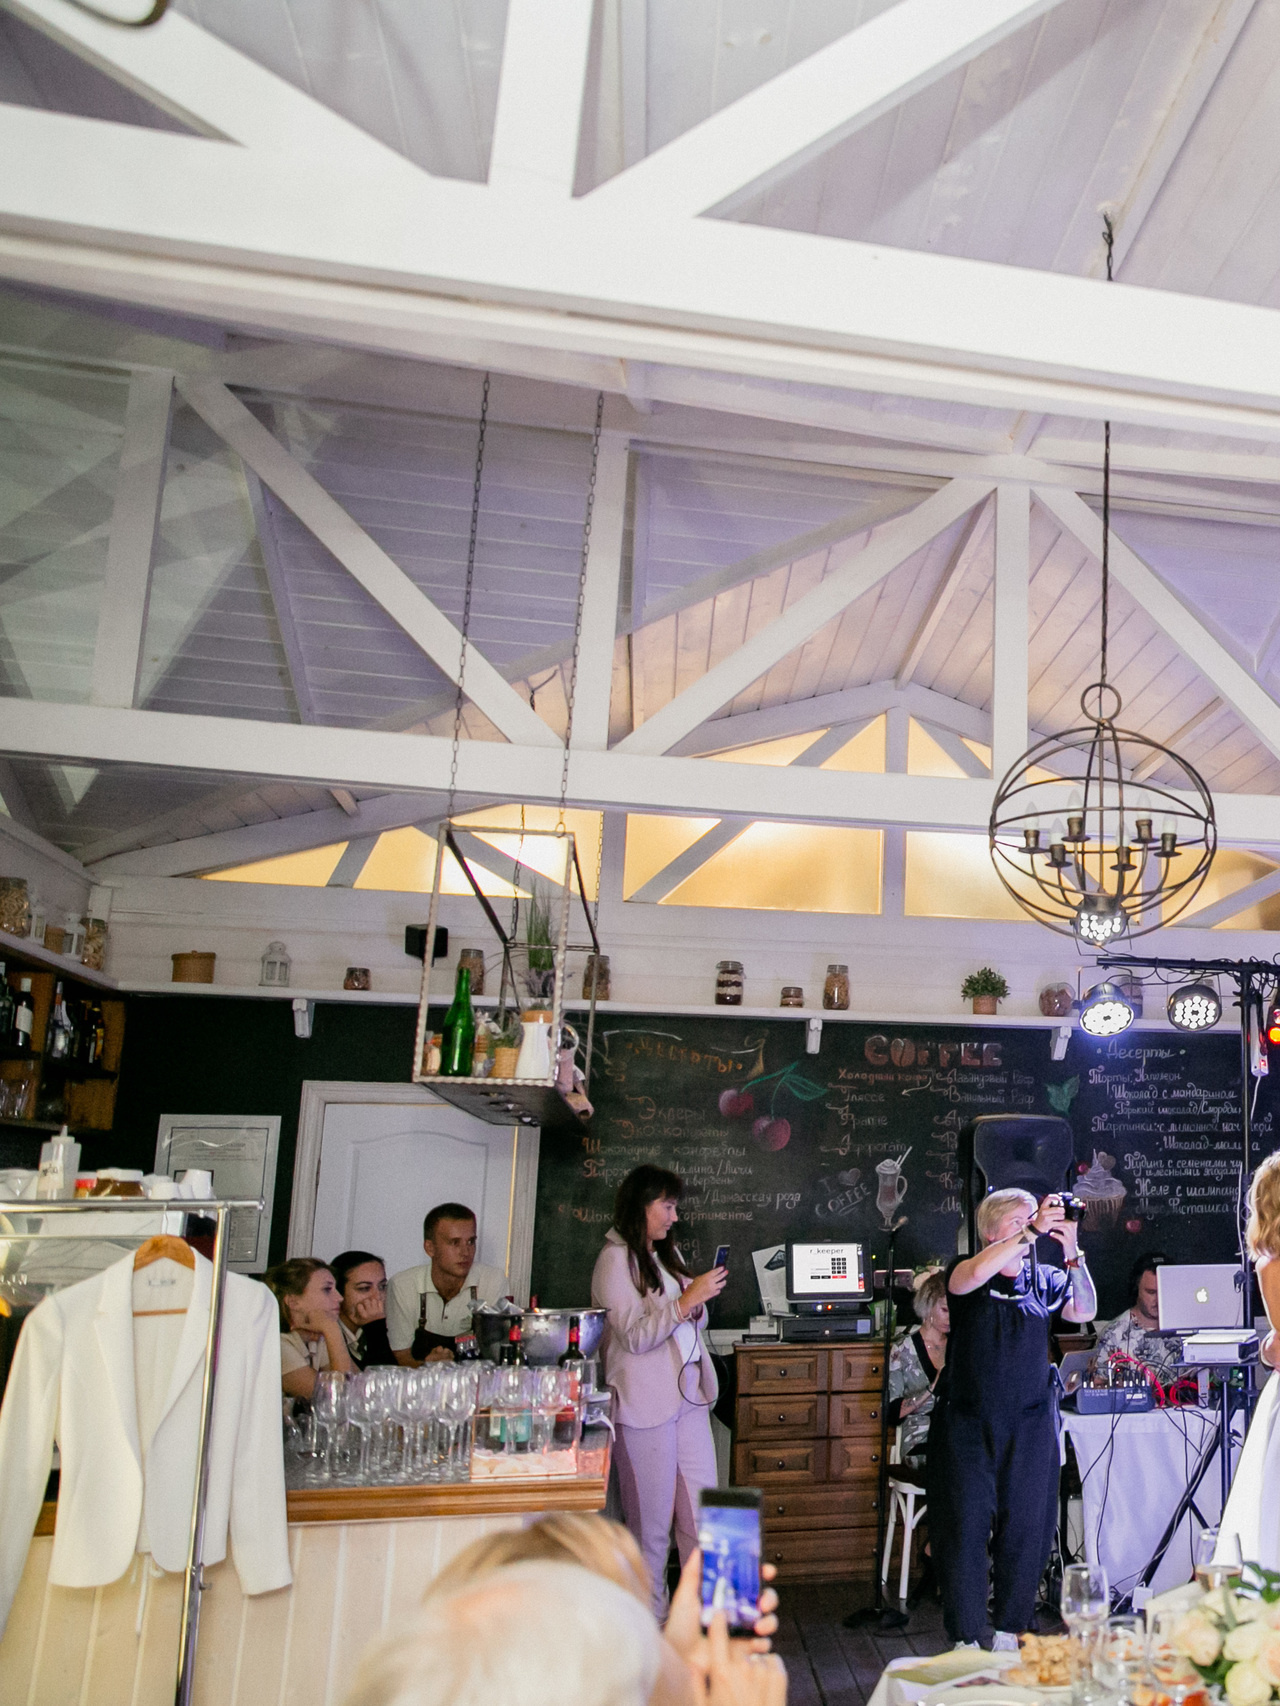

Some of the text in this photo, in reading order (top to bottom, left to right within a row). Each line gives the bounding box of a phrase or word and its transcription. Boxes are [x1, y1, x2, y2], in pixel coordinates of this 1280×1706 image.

[864, 1035, 1002, 1067] COFFEE
[1106, 1039, 1176, 1067] Десерты
[1112, 1082, 1238, 1103] Шоколад с мандарином
[1114, 1101, 1154, 1119] Горький
[1163, 1135, 1260, 1151] Шоколад-малиа
[1124, 1151, 1163, 1177] Пудинг
[1167, 1160, 1173, 1168] с
[1176, 1160, 1227, 1168] семенами
[1135, 1178, 1169, 1197] Желе
[1176, 1186, 1182, 1197] с
[776, 1192, 801, 1211] роза
[814, 1182, 871, 1217] COFFEE
[1168, 1198, 1229, 1214] Фисташка
